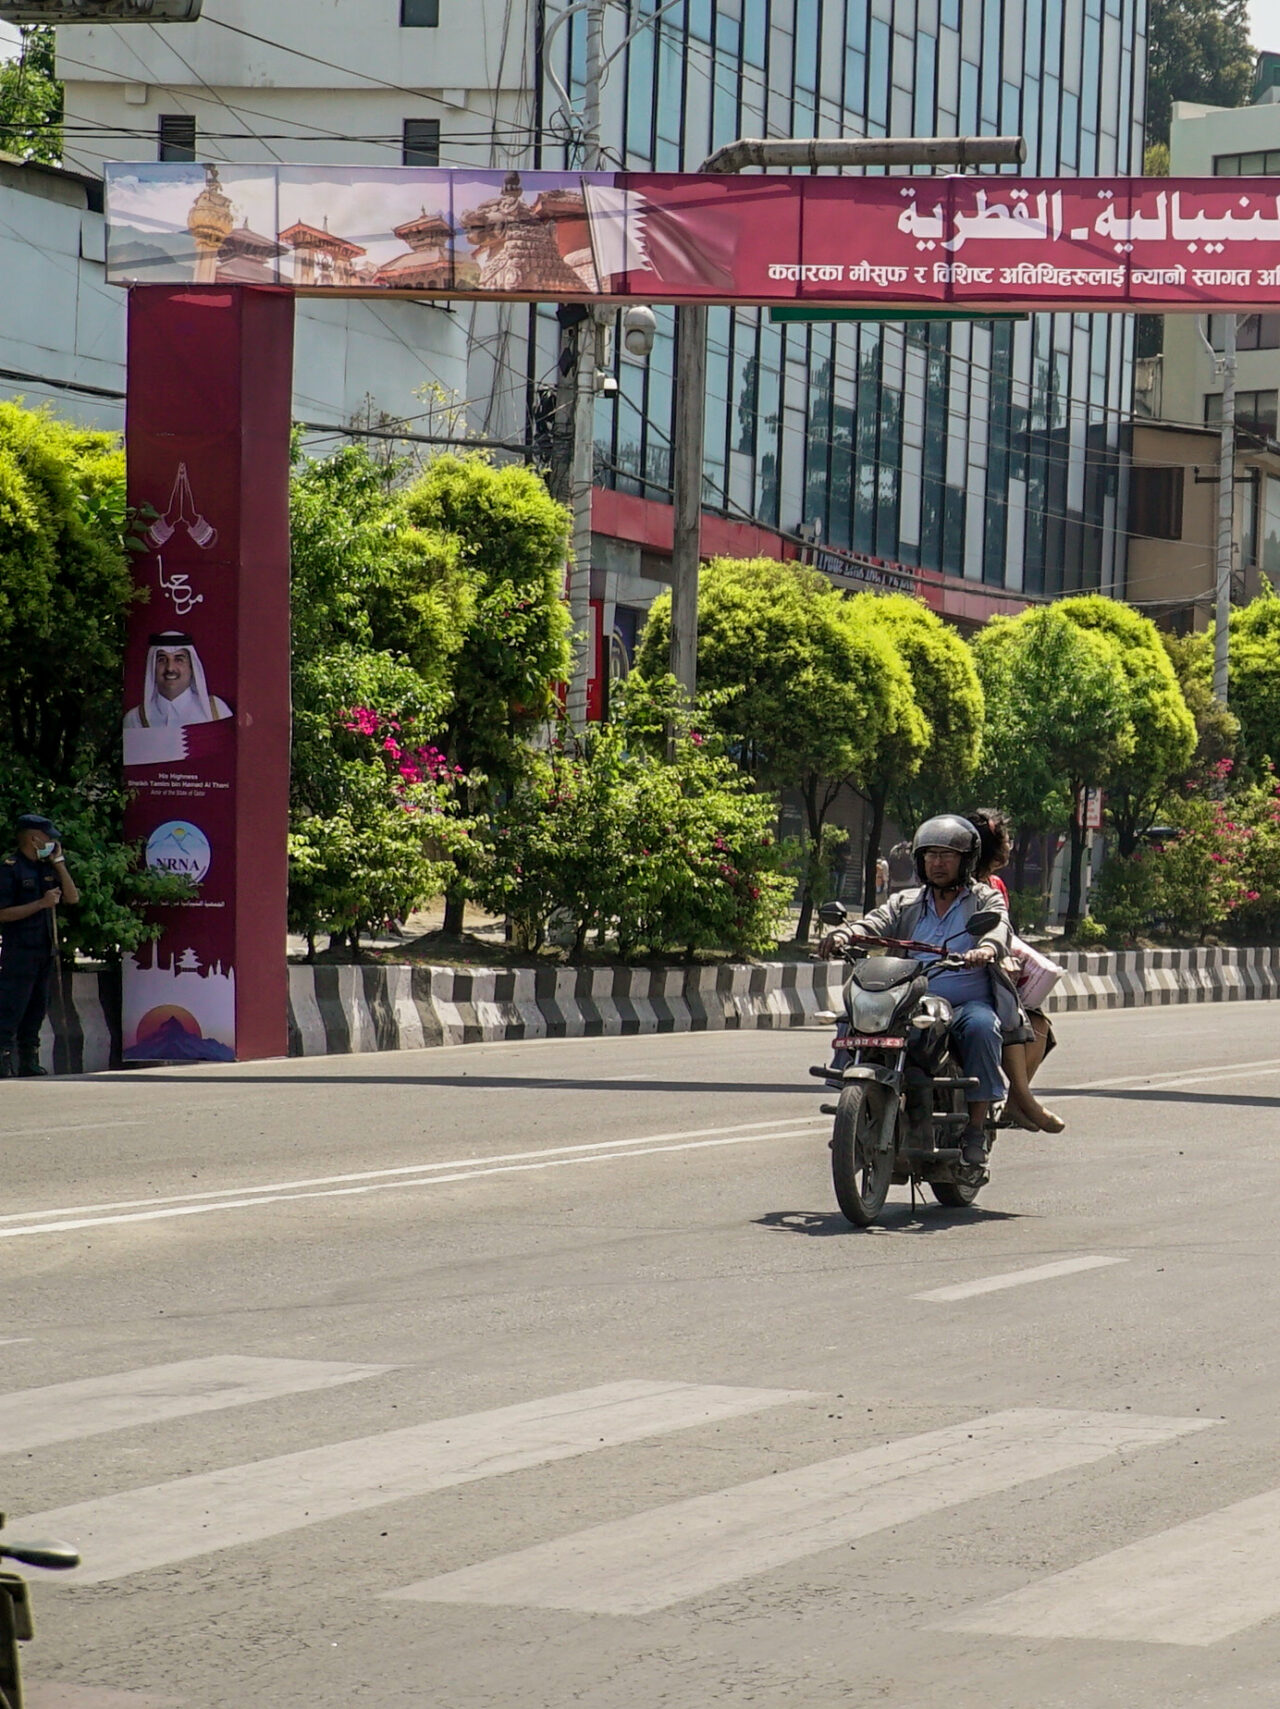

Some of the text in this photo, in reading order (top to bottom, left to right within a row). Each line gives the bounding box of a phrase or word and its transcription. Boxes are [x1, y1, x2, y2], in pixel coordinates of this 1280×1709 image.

[897, 188, 1063, 252] القطرية
[768, 263, 845, 282] कतारका
[849, 259, 910, 287] मौसुफ
[913, 266, 929, 284] र
[932, 261, 995, 285] विशिष्ट
[1131, 263, 1188, 285] न्यानो
[1191, 268, 1253, 287] स्वागत
[156, 554, 204, 615] مرحبا
